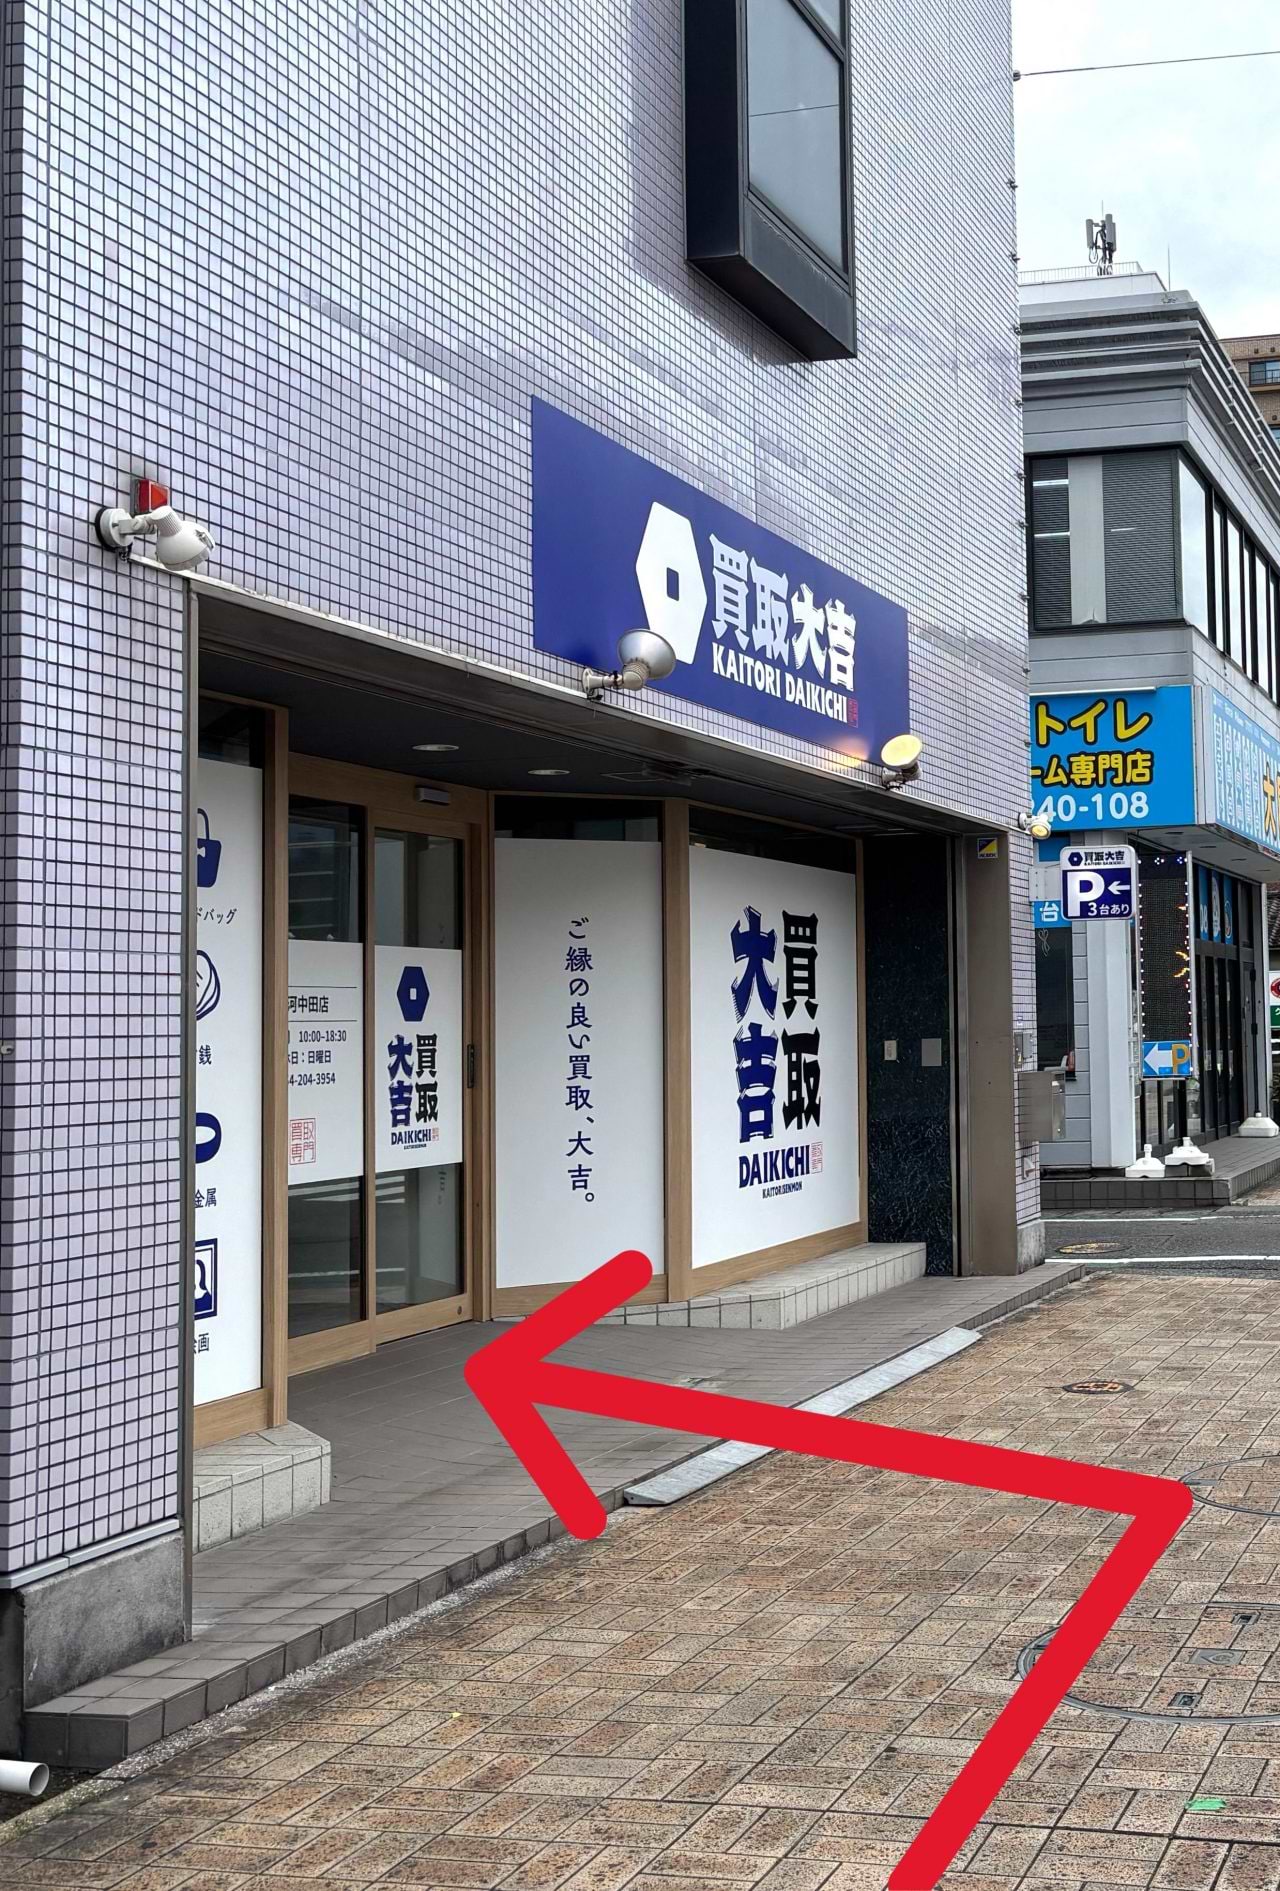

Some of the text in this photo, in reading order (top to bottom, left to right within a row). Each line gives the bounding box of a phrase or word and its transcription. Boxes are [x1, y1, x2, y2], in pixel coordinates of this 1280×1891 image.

[710, 533, 856, 692] 買取大吉
[712, 642, 781, 698] KAITORI
[785, 672, 847, 723] DAIKICHI
[1035, 698, 1153, 748] トイレ
[1031, 791, 1149, 823] 40-108
[1067, 871, 1105, 917] P
[1088, 902, 1129, 916] 3台あり
[730, 905, 779, 1143] 大吉
[782, 909, 821, 1130] 買取
[196, 1044, 212, 1065] 銭
[565, 916, 595, 1203] ご縁の良い買取、大吉。
[1172, 1044, 1190, 1075] P
[288, 1072, 336, 1087] 4-204-3954
[388, 1034, 414, 1128] 大吉
[416, 1033, 438, 1123] 買取
[391, 1128, 432, 1145] DAIKICHI
[739, 1144, 811, 1189] DAIKICHI
[194, 1333, 210, 1354] 画
